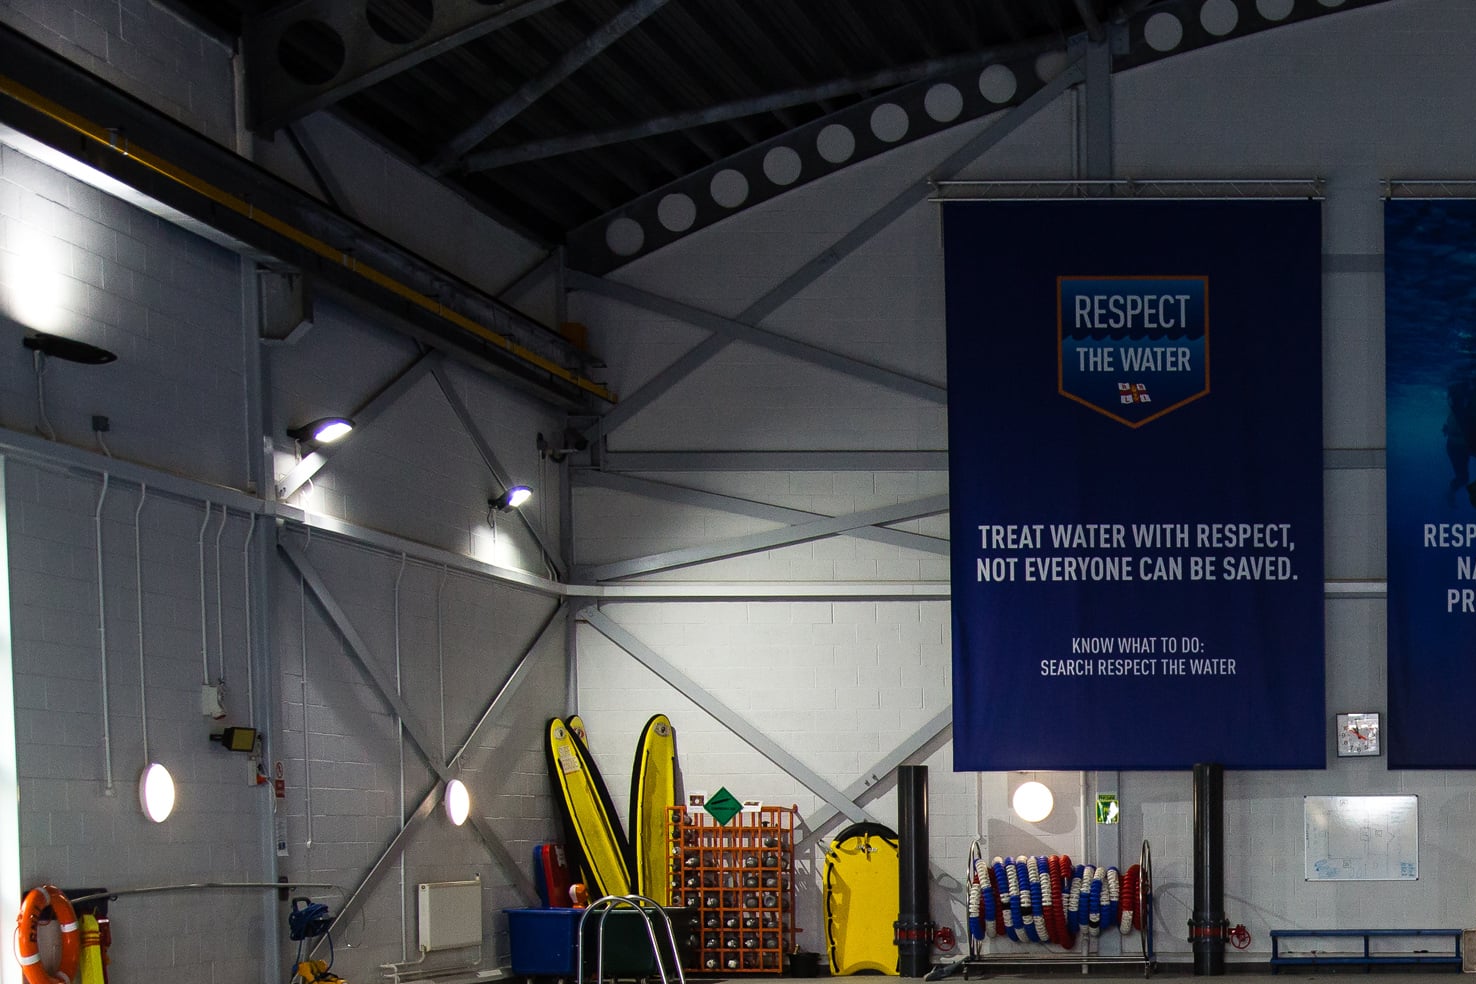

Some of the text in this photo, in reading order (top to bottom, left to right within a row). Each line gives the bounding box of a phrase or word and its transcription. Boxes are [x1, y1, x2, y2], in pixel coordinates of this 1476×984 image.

[1075, 294, 1191, 329] RESPECT
[1076, 347, 1191, 372] THE WATER
[978, 523, 1295, 552] TREAT WATER WITH RESPECT,
[976, 556, 1298, 582] NOT EVERYONE CAN BE SAVED.
[1072, 636, 1204, 654] KNOW WHAT TO DO:
[1040, 658, 1236, 676] SEARCH RESPECT THE WATER
